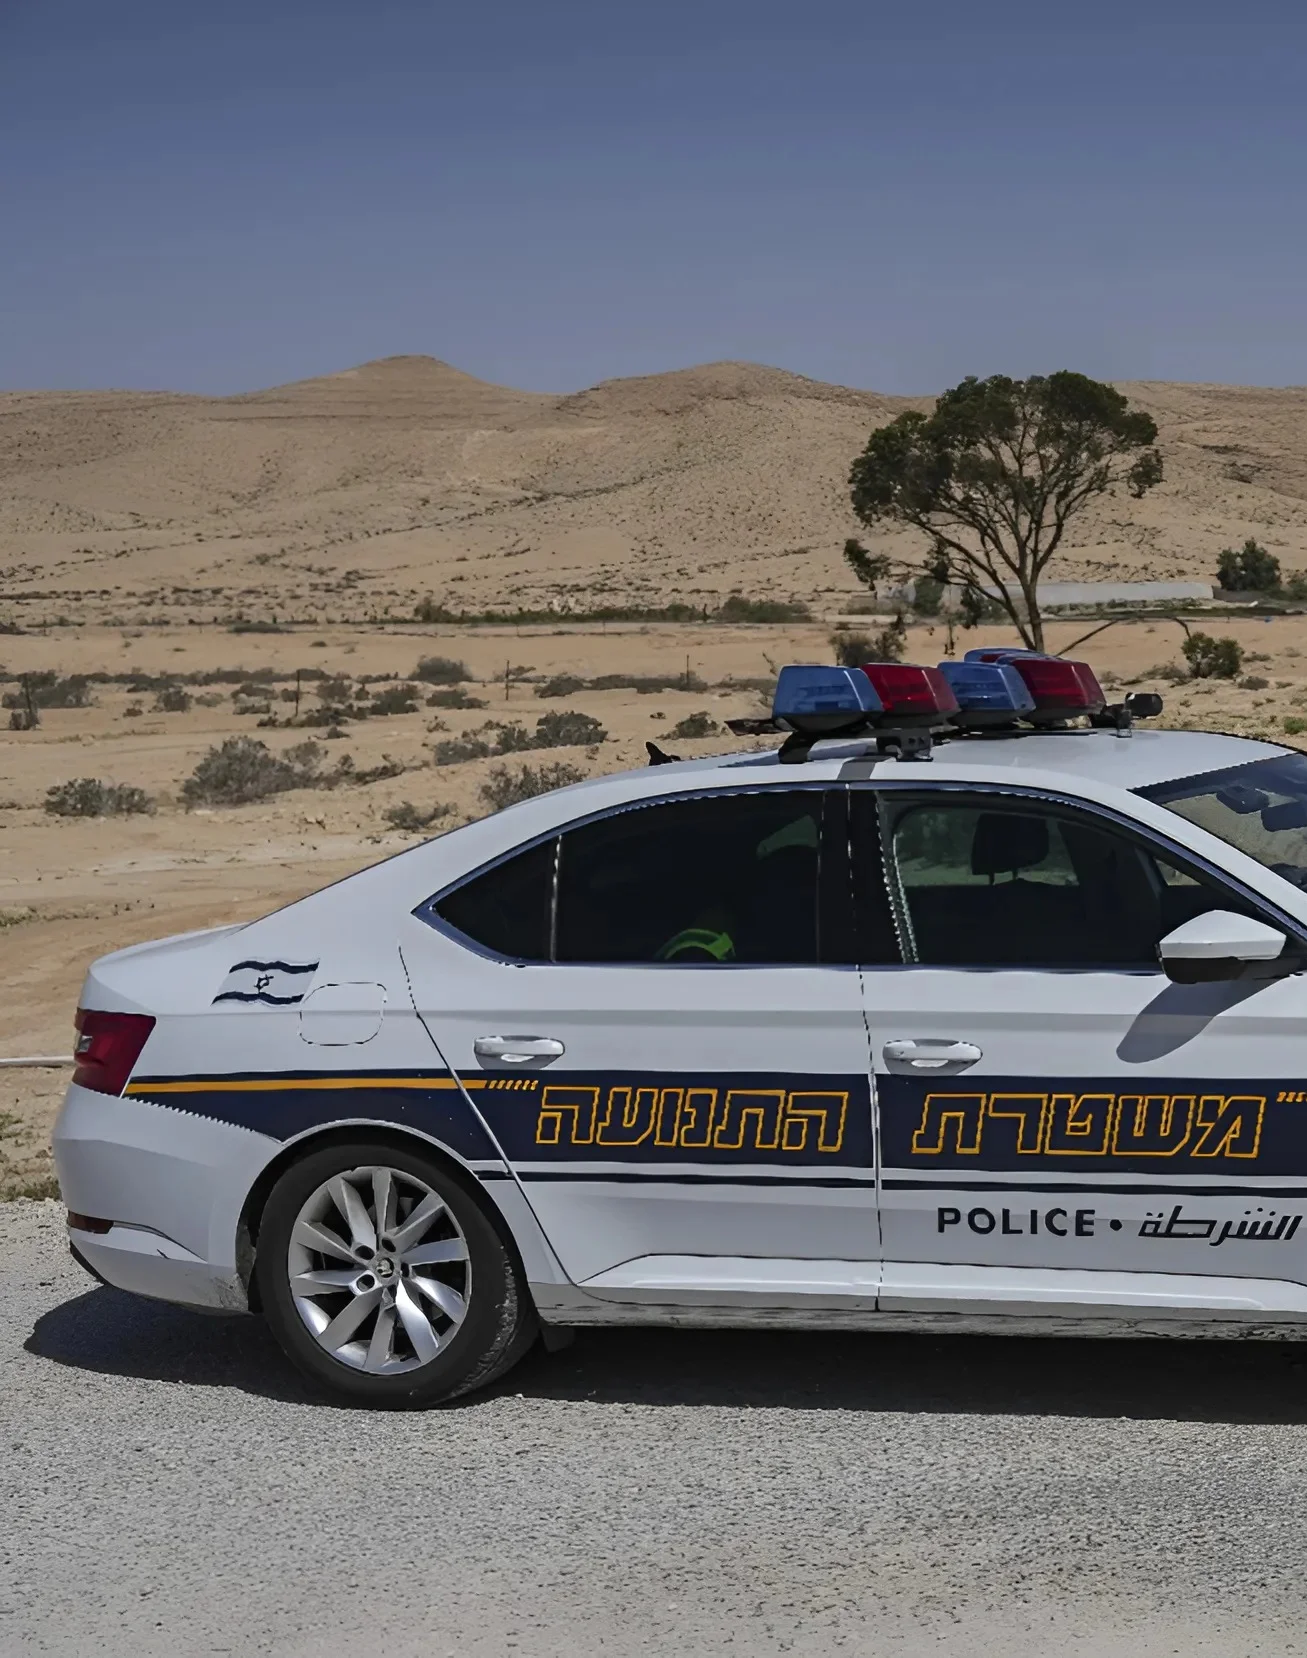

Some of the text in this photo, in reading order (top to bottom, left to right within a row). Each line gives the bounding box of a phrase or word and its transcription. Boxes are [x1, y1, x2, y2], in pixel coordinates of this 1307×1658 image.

[536, 1086, 1267, 1159] משטרת התנועה
[937, 1207, 1096, 1237] POLICE
[1137, 1205, 1304, 1247] الشرطة
